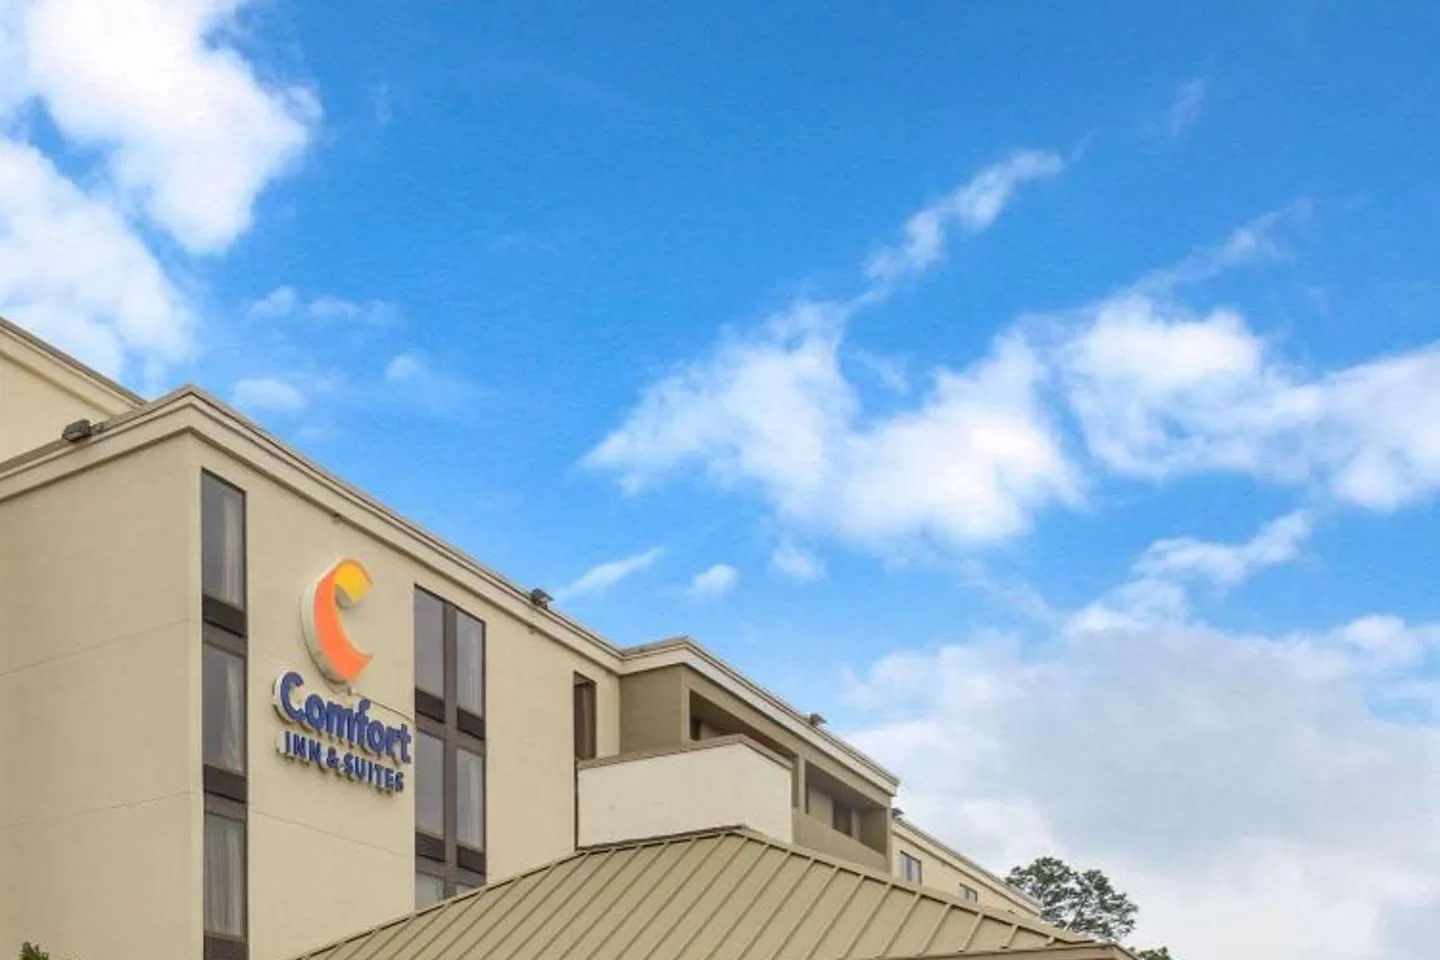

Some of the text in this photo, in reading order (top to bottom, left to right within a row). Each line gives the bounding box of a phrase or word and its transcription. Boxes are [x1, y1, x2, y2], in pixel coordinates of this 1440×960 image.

[277, 671, 412, 765] Comfort
[281, 731, 405, 793] INN & SUITES
